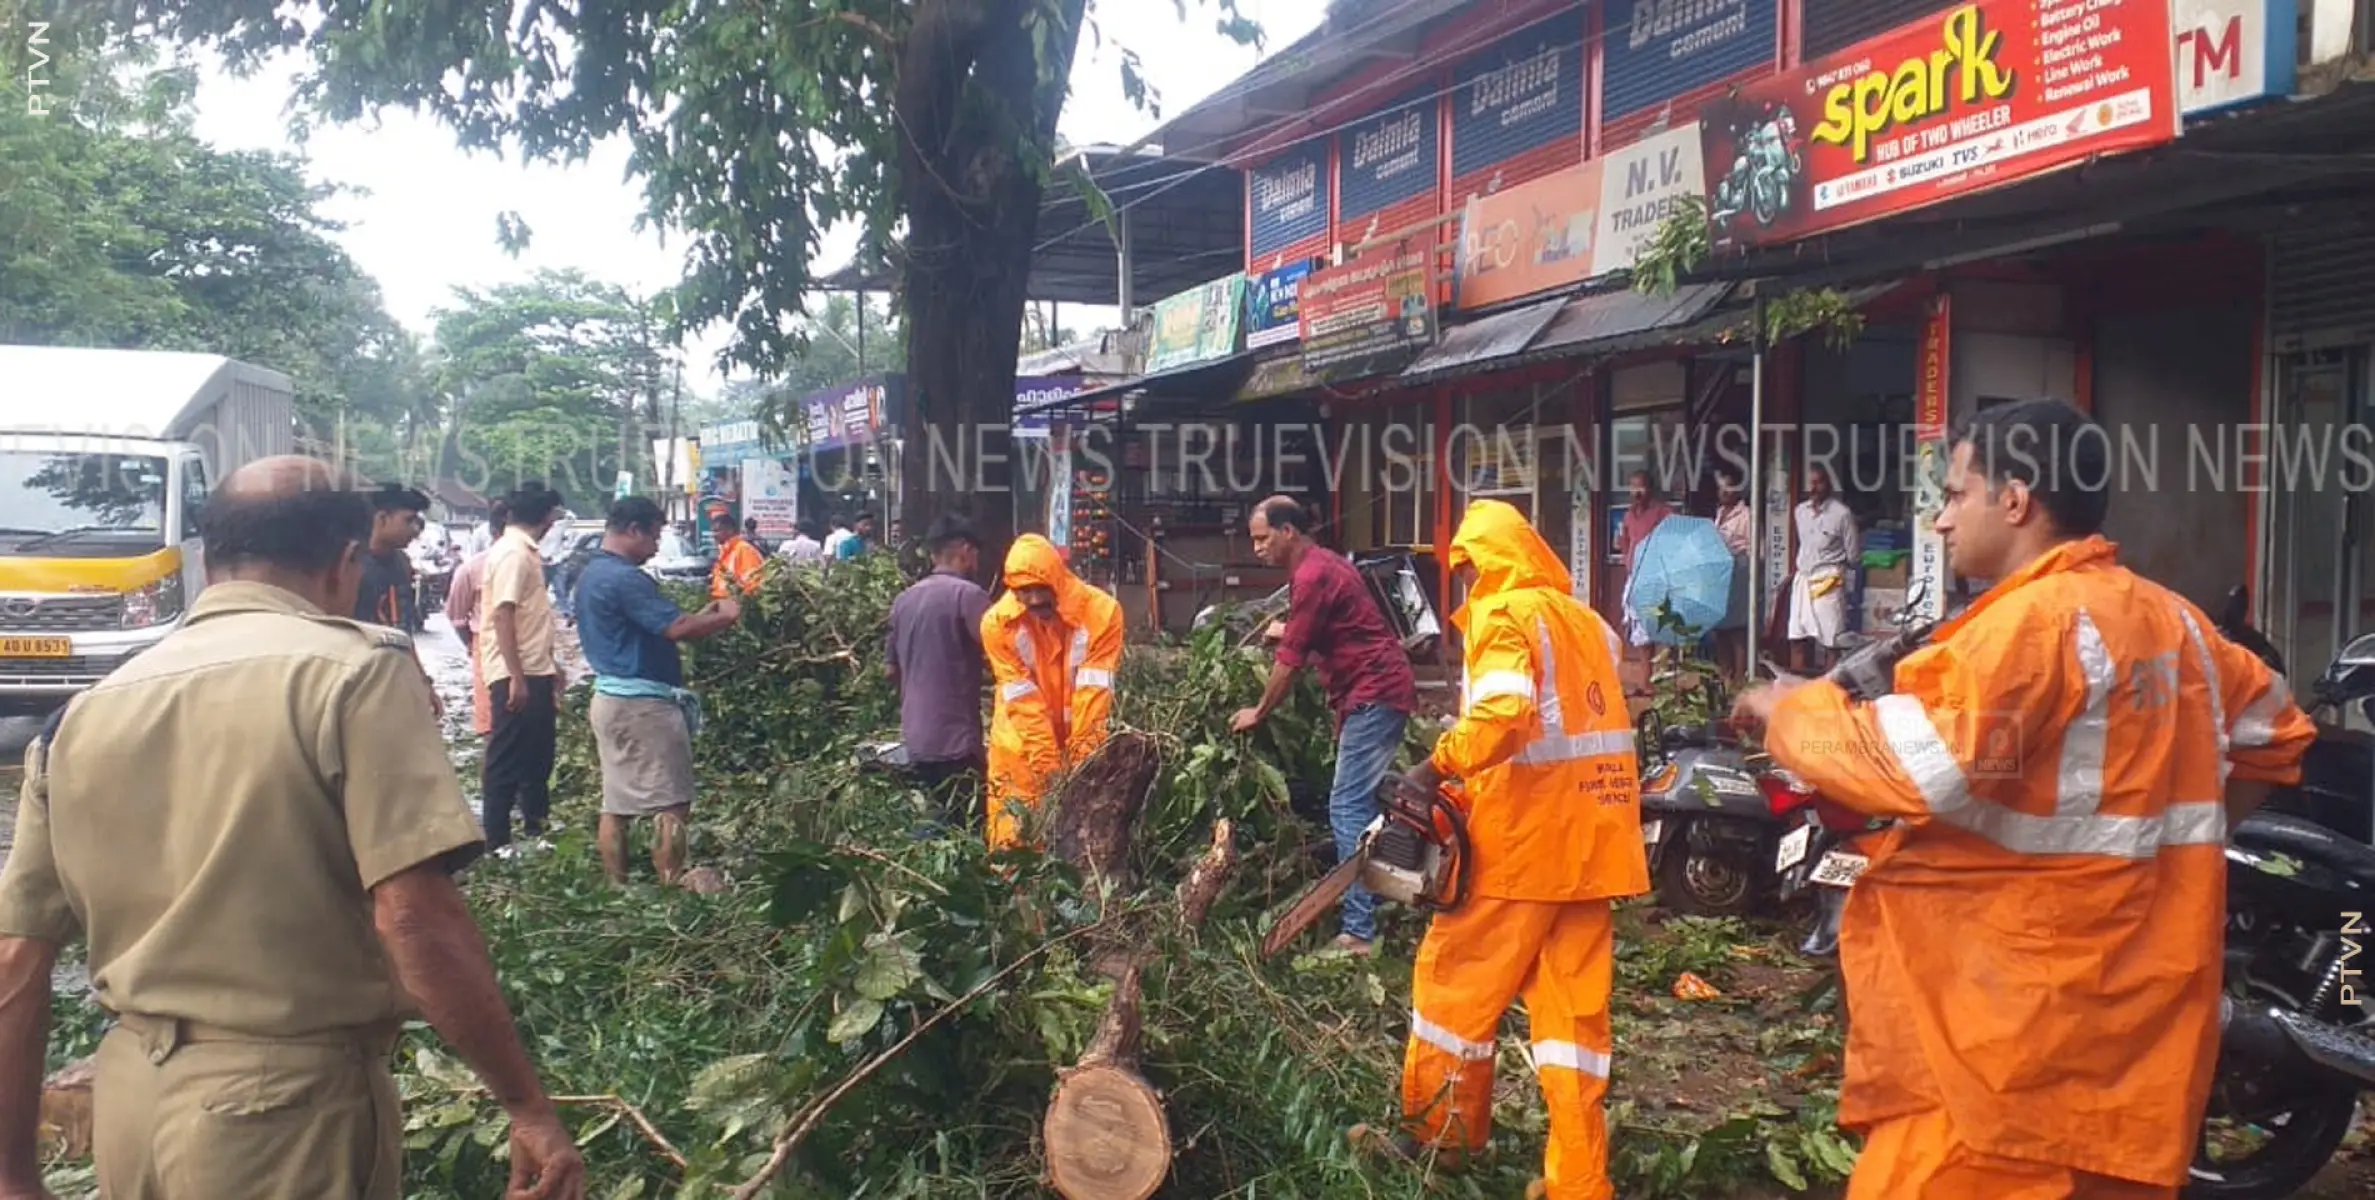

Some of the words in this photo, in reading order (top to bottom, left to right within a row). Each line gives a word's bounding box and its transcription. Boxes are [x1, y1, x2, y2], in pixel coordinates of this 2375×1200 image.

[2041, 23, 2081, 46] Engine
[2083, 13, 2099, 31] Oil
[2043, 39, 2087, 65] Electric
[2088, 26, 2121, 49] Work
[1471, 43, 1560, 116] Dalmia
[1811, 4, 2011, 163] spark
[2070, 53, 2103, 75] Work
[2096, 65, 2130, 87] Work
[1353, 109, 1422, 169] Dalmia
[1876, 139, 1900, 163] HUB
[1903, 133, 1919, 155] OF
[1920, 123, 1948, 149] TWO
[1949, 104, 2011, 141] WHEELER
[1261, 157, 1316, 212] Dalmia
[1626, 145, 1682, 199] N.V.
[1899, 155, 1945, 179] SUZUKI
[1952, 144, 1979, 165] TVS
